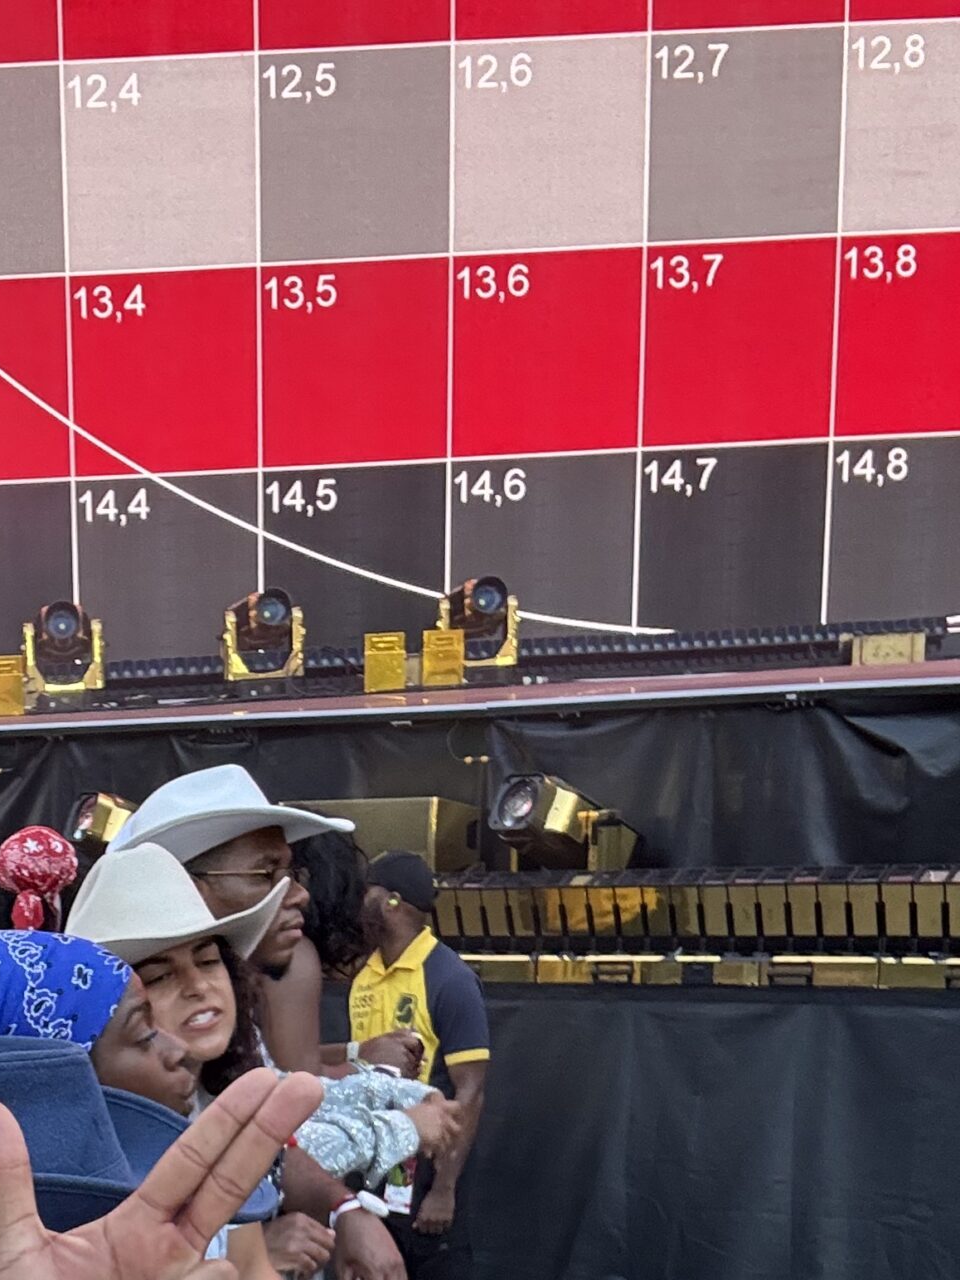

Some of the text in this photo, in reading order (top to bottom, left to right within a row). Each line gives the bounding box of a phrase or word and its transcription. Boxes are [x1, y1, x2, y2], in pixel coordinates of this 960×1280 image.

[458, 52, 532, 93] 12,6
[655, 43, 729, 84] 12,7
[851, 33, 925, 74] 12,8
[67, 72, 142, 113] 12,4
[262, 62, 336, 103] 12,5
[457, 263, 530, 302] 13,6
[650, 253, 724, 292] 13,7
[844, 244, 917, 282] 13,8
[73, 284, 146, 322] 13,4
[264, 274, 337, 313] 13,5
[644, 457, 718, 497] 14,7
[835, 447, 908, 487] 14,8
[78, 487, 151, 526] 14,4
[265, 478, 338, 517] 14,5
[453, 468, 526, 507] 14,6
